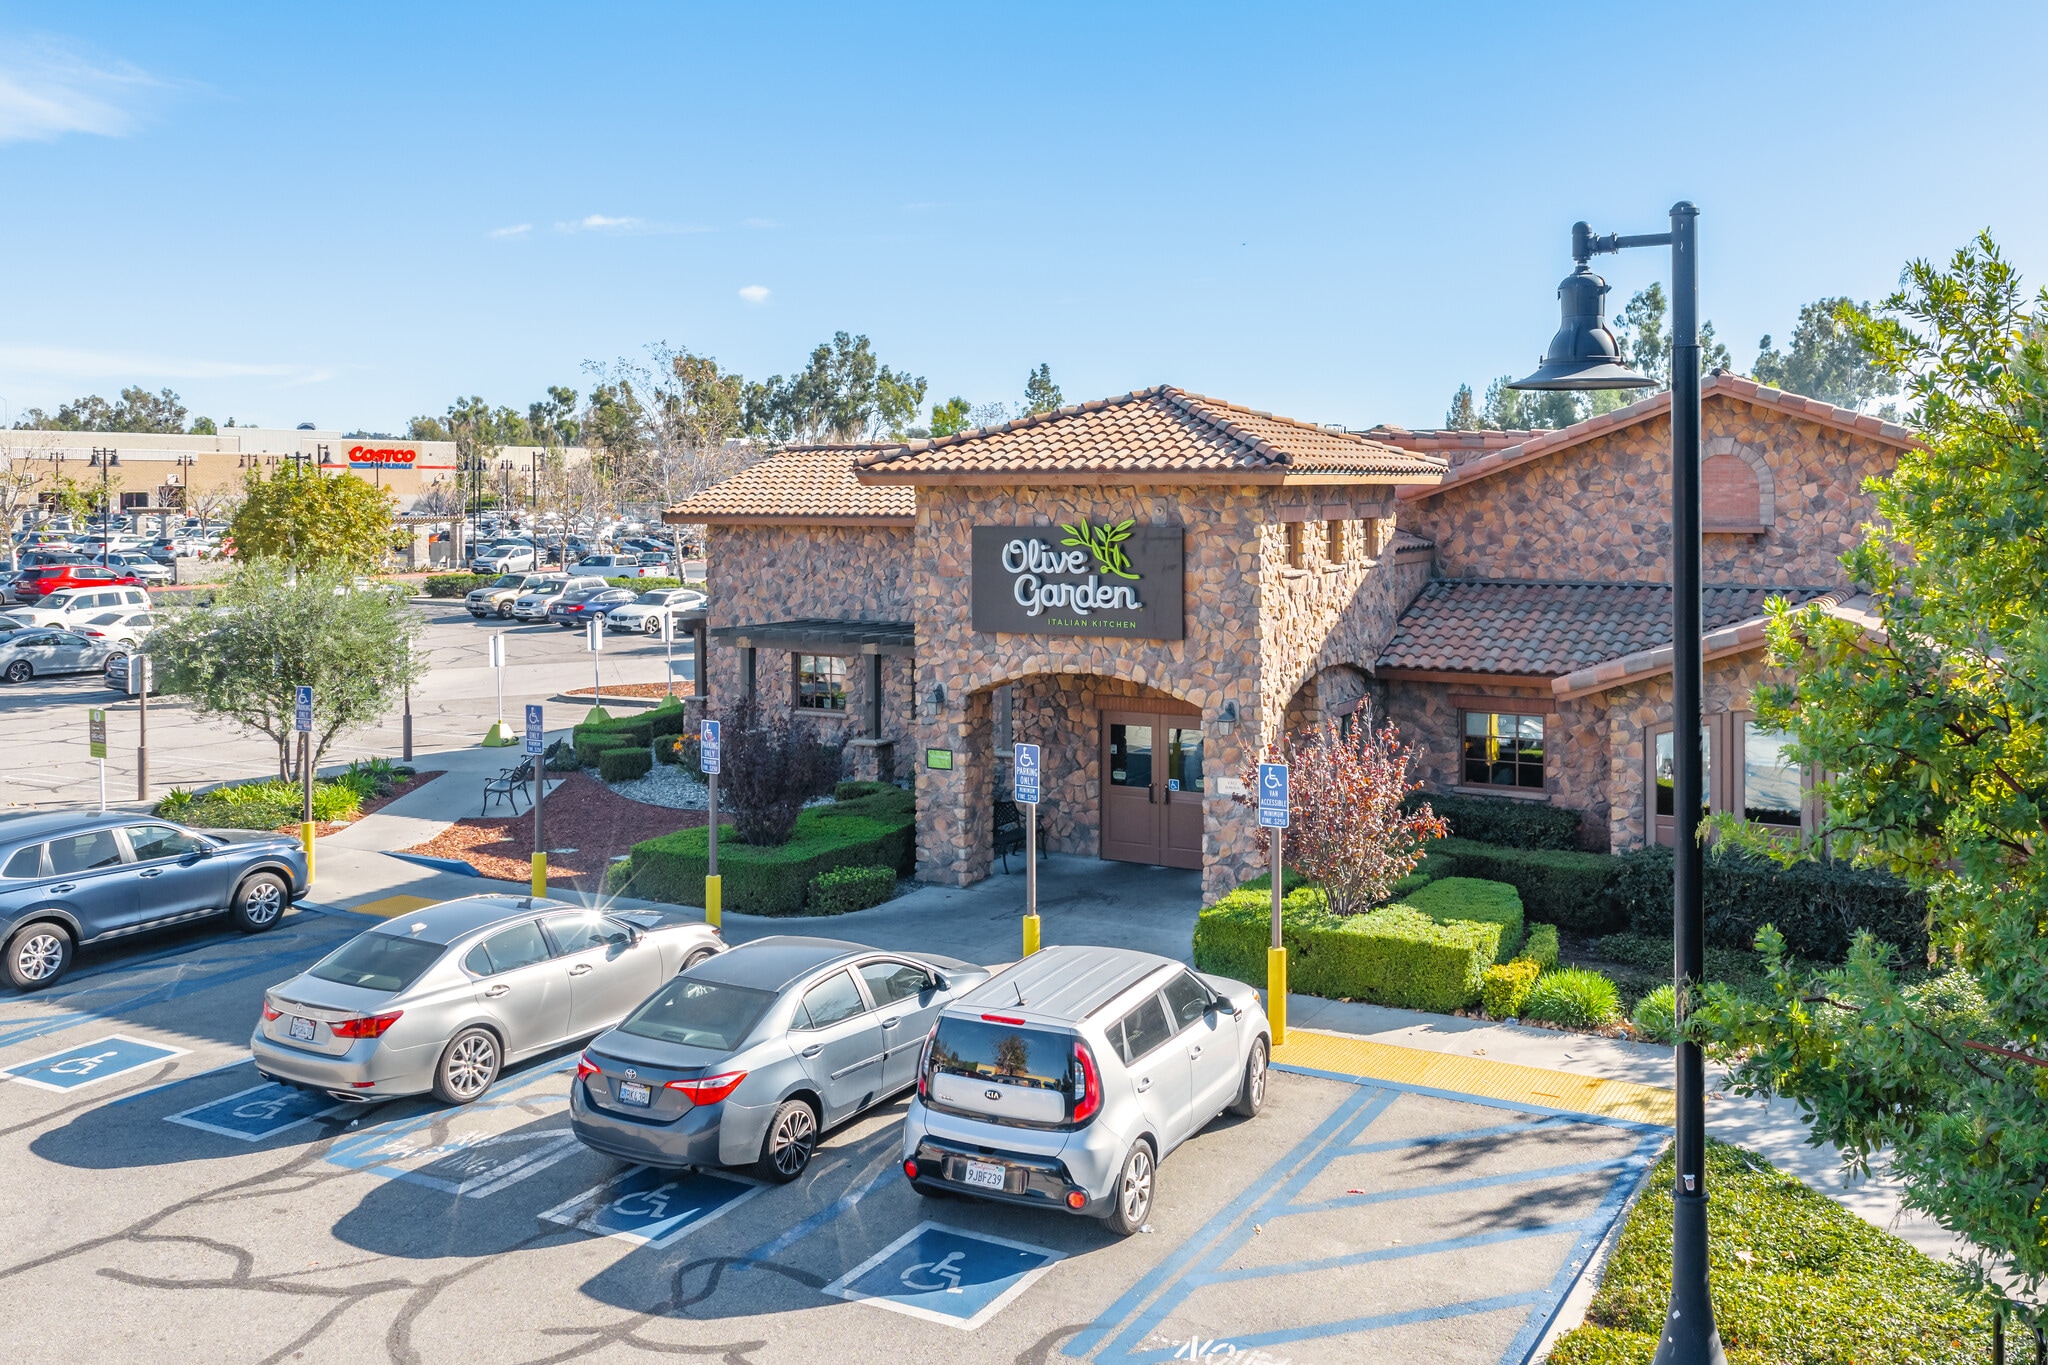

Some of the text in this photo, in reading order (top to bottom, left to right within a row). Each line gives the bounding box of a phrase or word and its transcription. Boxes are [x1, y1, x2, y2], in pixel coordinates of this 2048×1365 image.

[348, 445, 416, 463] COSTCO
[1001, 538, 1089, 574] Olive
[1014, 574, 1143, 616] Garden
[1047, 618, 1137, 629] ITALIAN KITCHEN
[702, 740, 719, 749] PARKING
[704, 749, 715, 758] ONLY
[1016, 767, 1038, 777] PARKING
[1020, 776, 1035, 786] ONLY
[1260, 799, 1287, 808] ACCESSIBLE
[1263, 810, 1284, 818] MINIMUM
[1261, 817, 1272, 825] FINE
[986, 1091, 999, 1099] KIA
[968, 1169, 1002, 1186] 9JBF239
